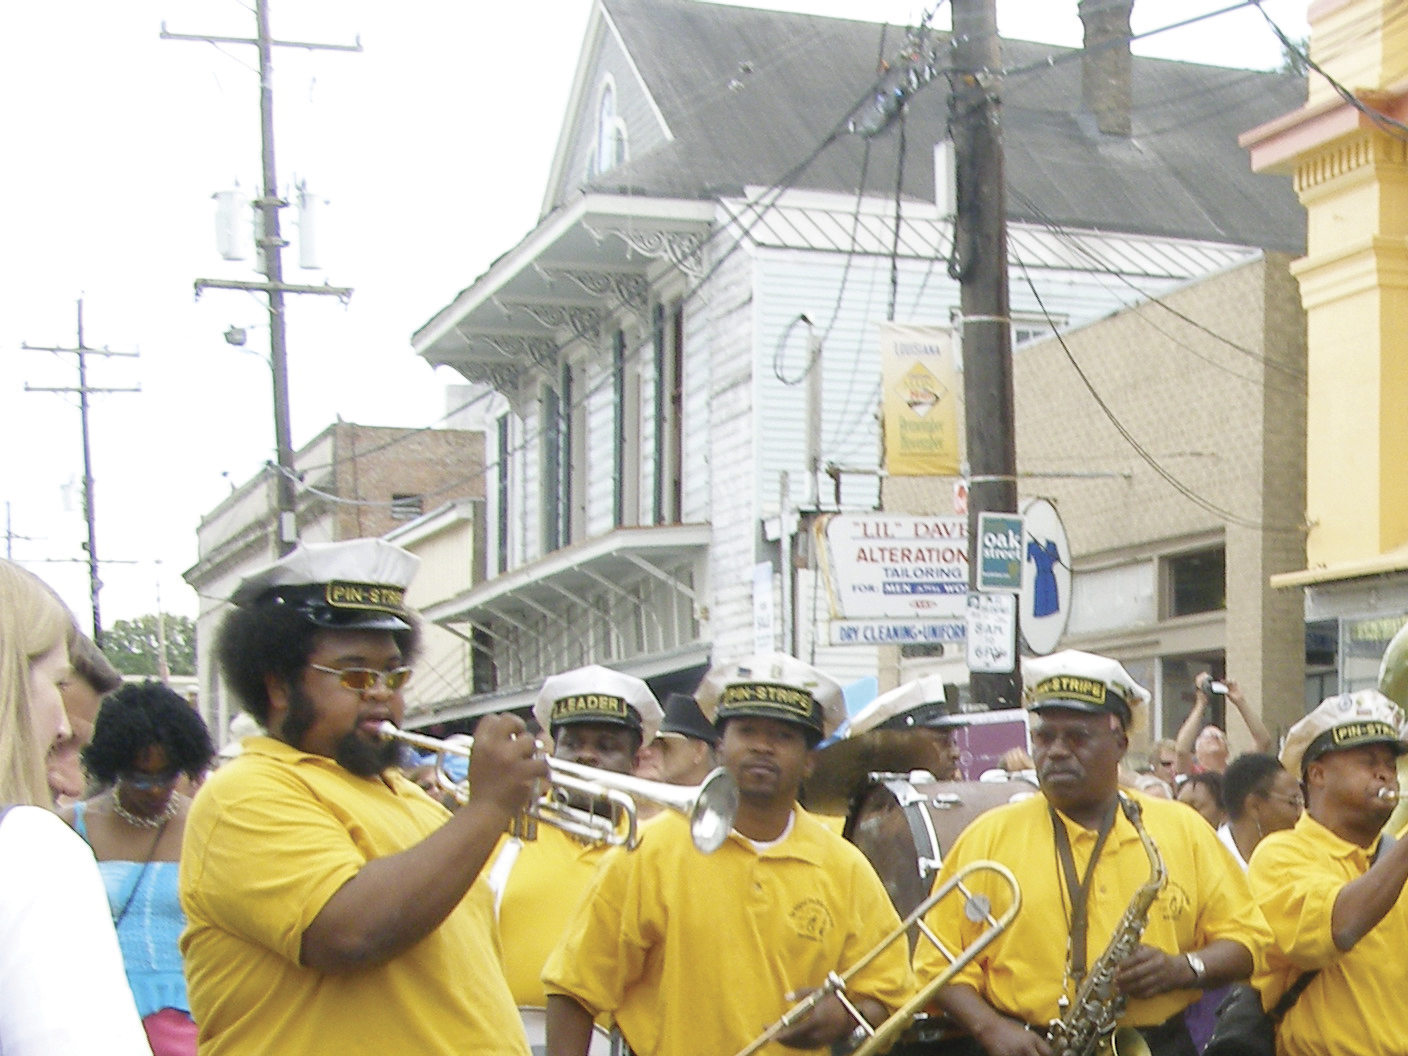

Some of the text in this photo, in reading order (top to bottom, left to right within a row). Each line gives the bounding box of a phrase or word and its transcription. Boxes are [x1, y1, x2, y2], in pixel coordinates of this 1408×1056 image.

[984, 529, 1021, 550] oak
[983, 549, 1021, 562] street
[884, 567, 962, 579] TAILORING
[885, 583, 911, 594] MEN
[840, 625, 859, 641] DRY
[863, 625, 918, 641] CLEANING
[560, 695, 619, 712] LEADER
